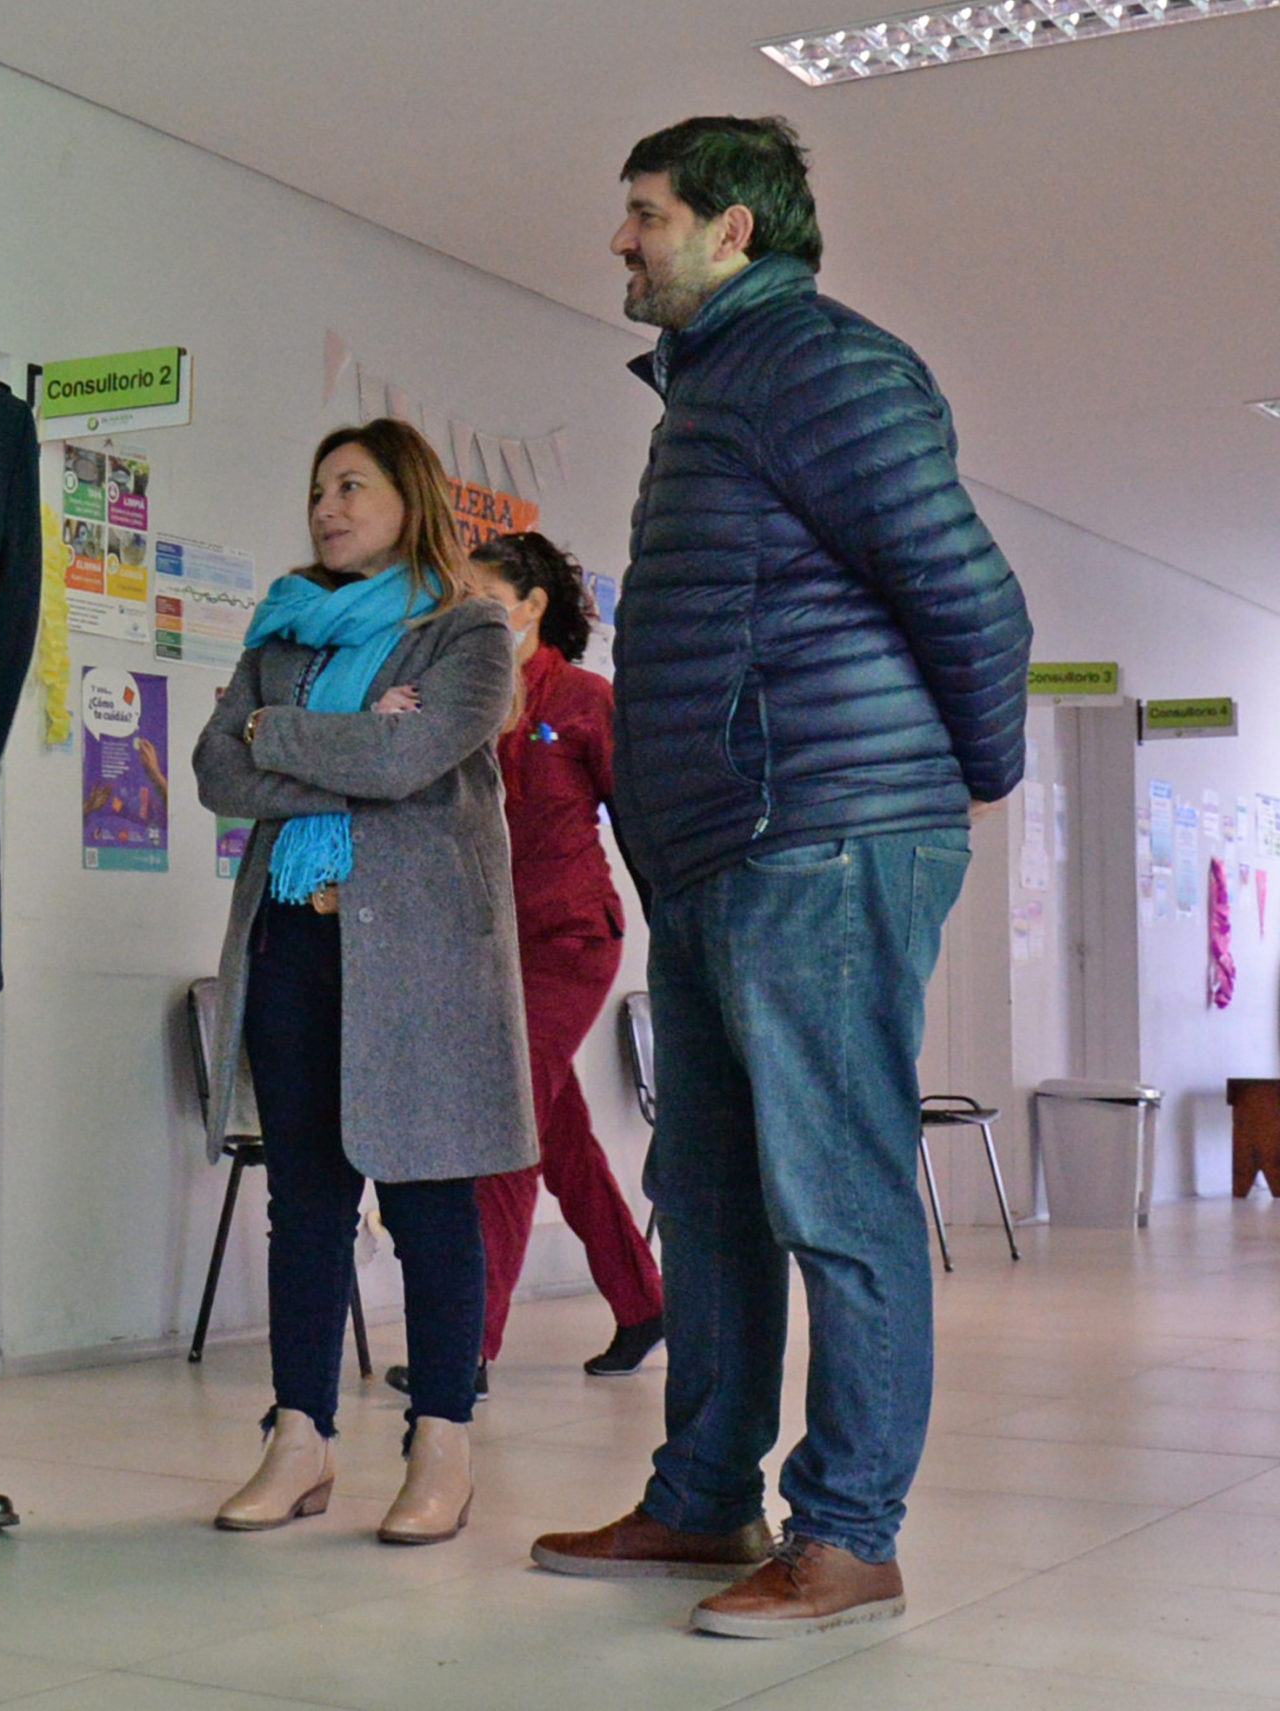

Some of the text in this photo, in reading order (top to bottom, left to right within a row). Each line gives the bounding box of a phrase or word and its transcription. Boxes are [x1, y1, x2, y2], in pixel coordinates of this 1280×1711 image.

[47, 365, 172, 400] Consultorio 2
[1028, 670, 1112, 684] Consultorio 3
[1149, 706, 1218, 719] Consultorio
